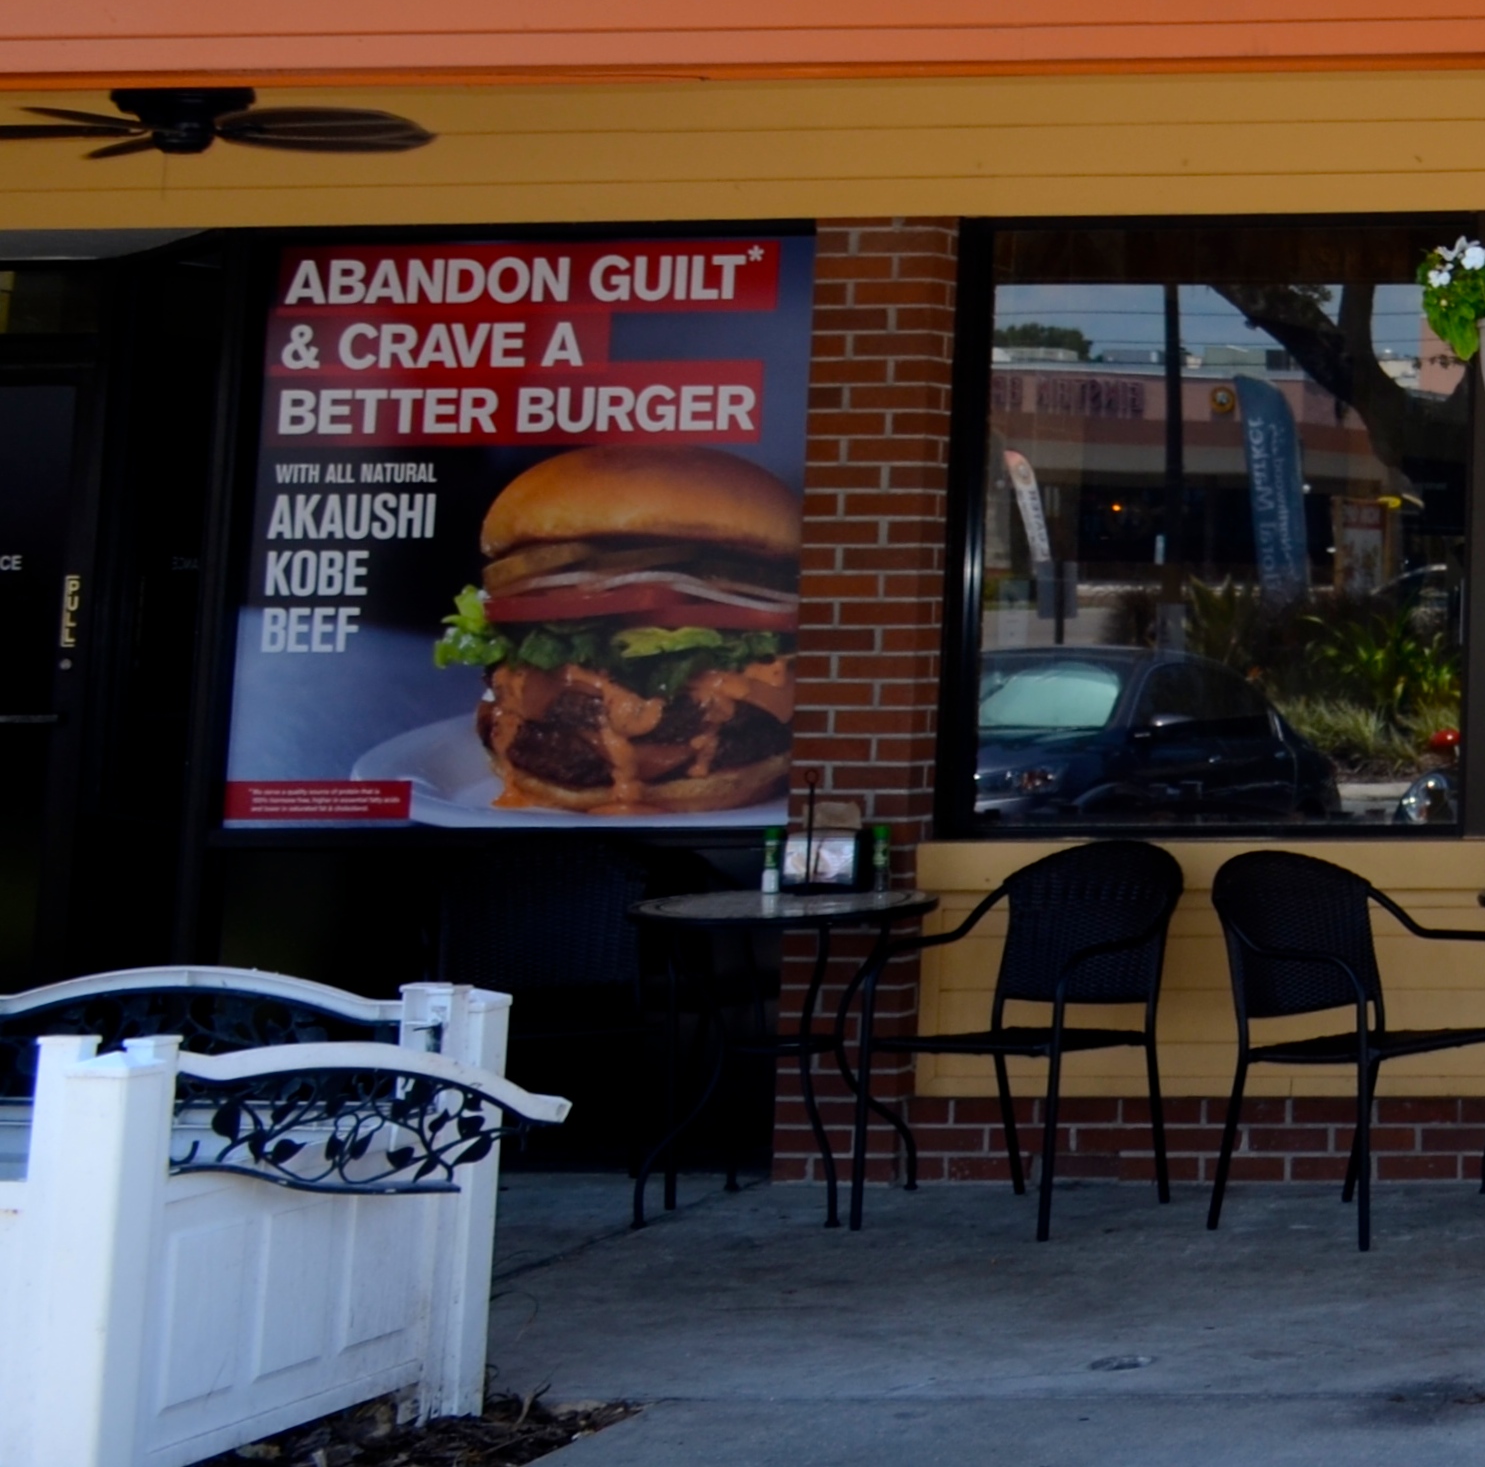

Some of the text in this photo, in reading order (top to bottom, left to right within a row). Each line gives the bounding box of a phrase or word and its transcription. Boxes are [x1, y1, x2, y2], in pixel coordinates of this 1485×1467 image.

[285, 255, 570, 304] ABANDON
[281, 321, 583, 369] & CRAVE A
[277, 385, 756, 435] BETTER BURGER
[275, 462, 437, 484] WITH ALL NATURAL
[267, 492, 437, 540] AKAUSHI
[264, 549, 369, 596] KOBE
[61, 579, 81, 644] PULL
[260, 607, 360, 653] BEEF
